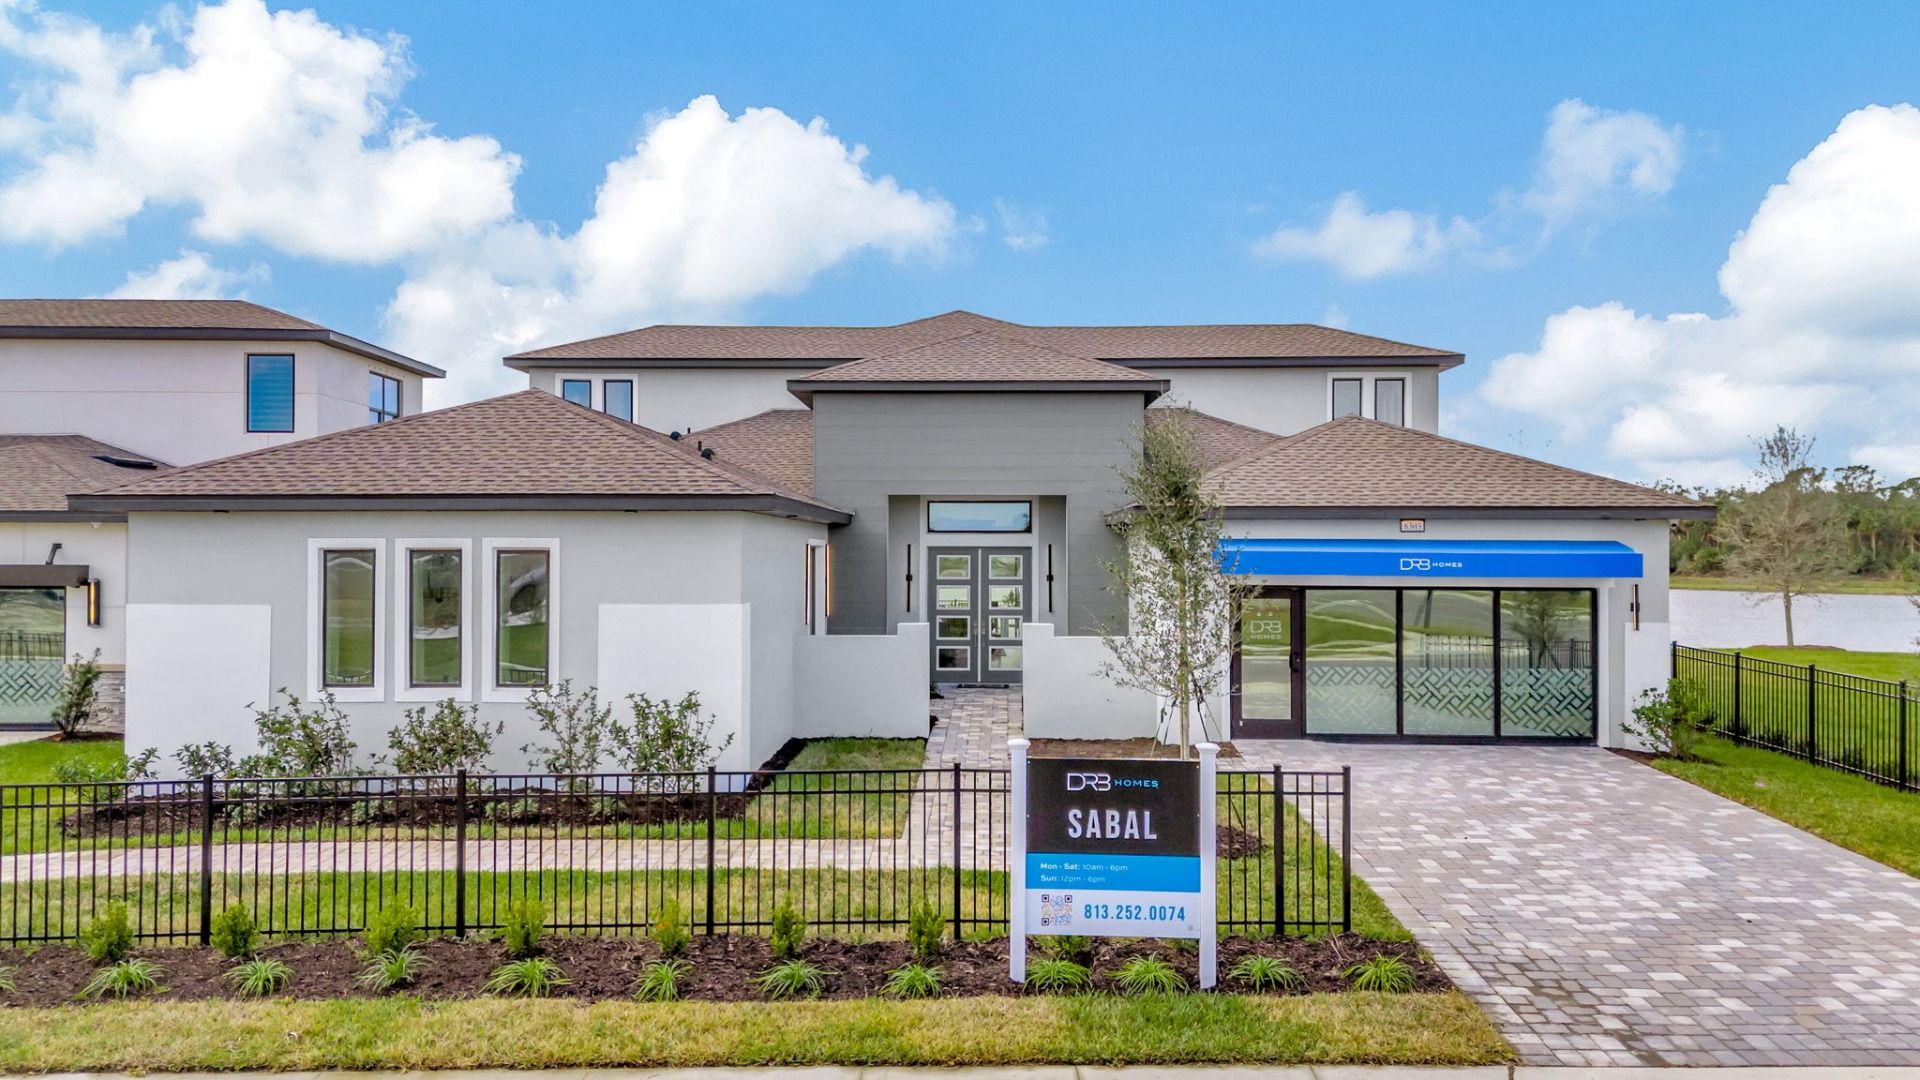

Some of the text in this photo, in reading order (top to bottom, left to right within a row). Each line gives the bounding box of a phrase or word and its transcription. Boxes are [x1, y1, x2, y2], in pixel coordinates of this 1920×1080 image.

[1400, 558, 1430, 571] DRB
[1250, 620, 1282, 633] DRB
[1067, 773, 1159, 791] DRB HOMES
[1068, 809, 1157, 840] SABAL
[1110, 864, 1128, 872] 6pm
[1040, 874, 1059, 882] Sun:
[1061, 875, 1081, 883] 12pm
[1084, 904, 1185, 921] 813.252.0074
